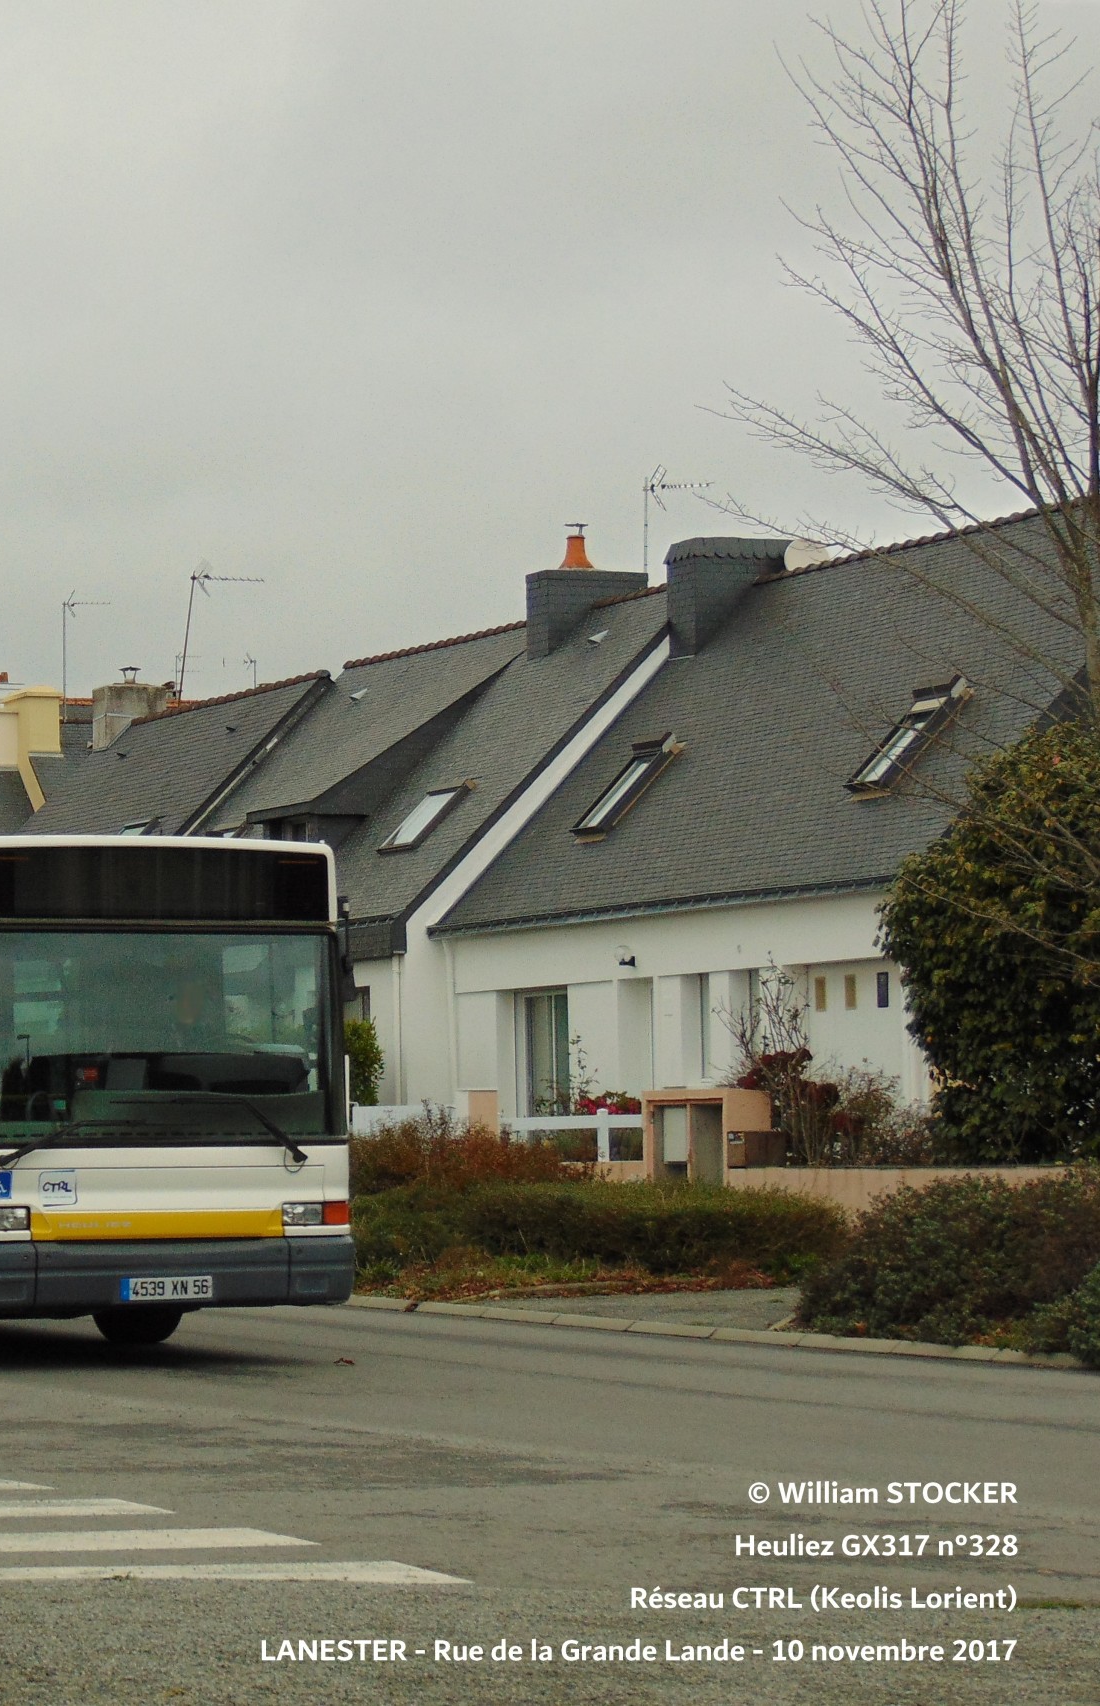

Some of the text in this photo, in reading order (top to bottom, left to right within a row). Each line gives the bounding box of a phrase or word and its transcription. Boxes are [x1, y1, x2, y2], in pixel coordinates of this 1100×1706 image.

[42, 1180, 73, 1193] CTRL
[132, 1279, 209, 1297] 4539 XN 56
